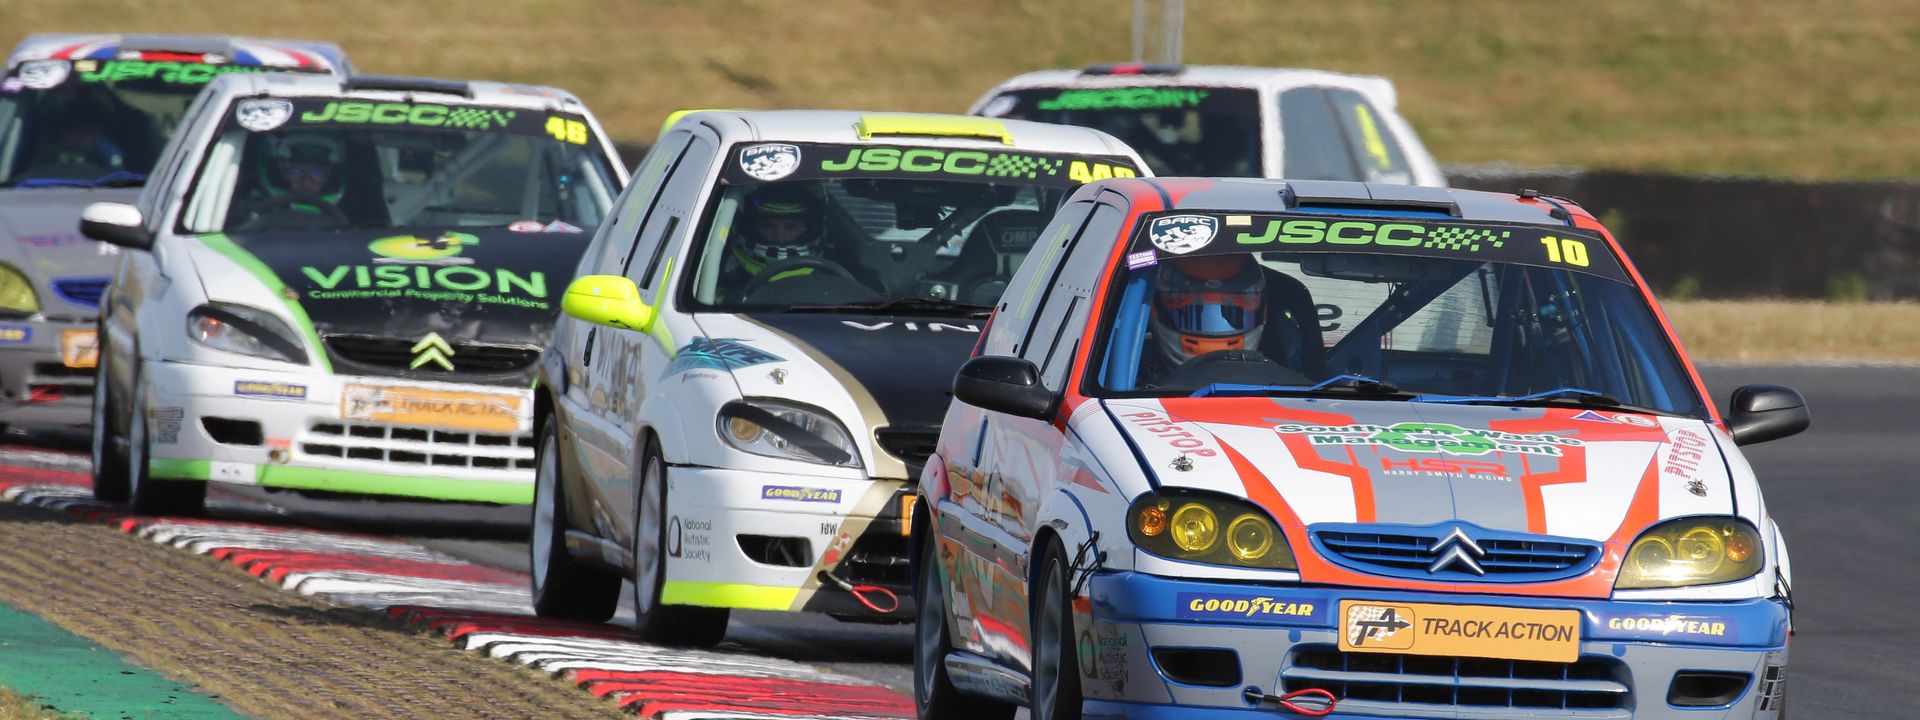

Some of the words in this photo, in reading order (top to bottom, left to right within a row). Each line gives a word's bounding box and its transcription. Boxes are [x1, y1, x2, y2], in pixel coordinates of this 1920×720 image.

[302, 102, 448, 126] JSCC
[821, 148, 988, 175] JSCC
[1158, 217, 1211, 226] BARC
[1236, 220, 1425, 247] JSCC
[1540, 236, 1590, 267] 10
[301, 265, 547, 298] VISION
[308, 289, 401, 299] Commercial
[405, 289, 474, 304] Property
[477, 292, 550, 310] Solutions
[1120, 412, 1217, 457] PITSTOP
[1276, 424, 1453, 436] Southern
[1467, 429, 1584, 446] Waste
[1314, 435, 1562, 456] Management
[1427, 471, 1463, 479] SMITH
[1470, 474, 1512, 482] RACING
[765, 487, 838, 501] GOODYEAR
[684, 519, 712, 531] National
[684, 533, 710, 545] Autistic
[684, 550, 711, 562] Society
[1189, 597, 1314, 617] GOODYEAR
[1422, 617, 1494, 639] TRACK
[1493, 621, 1574, 642] ACTION
